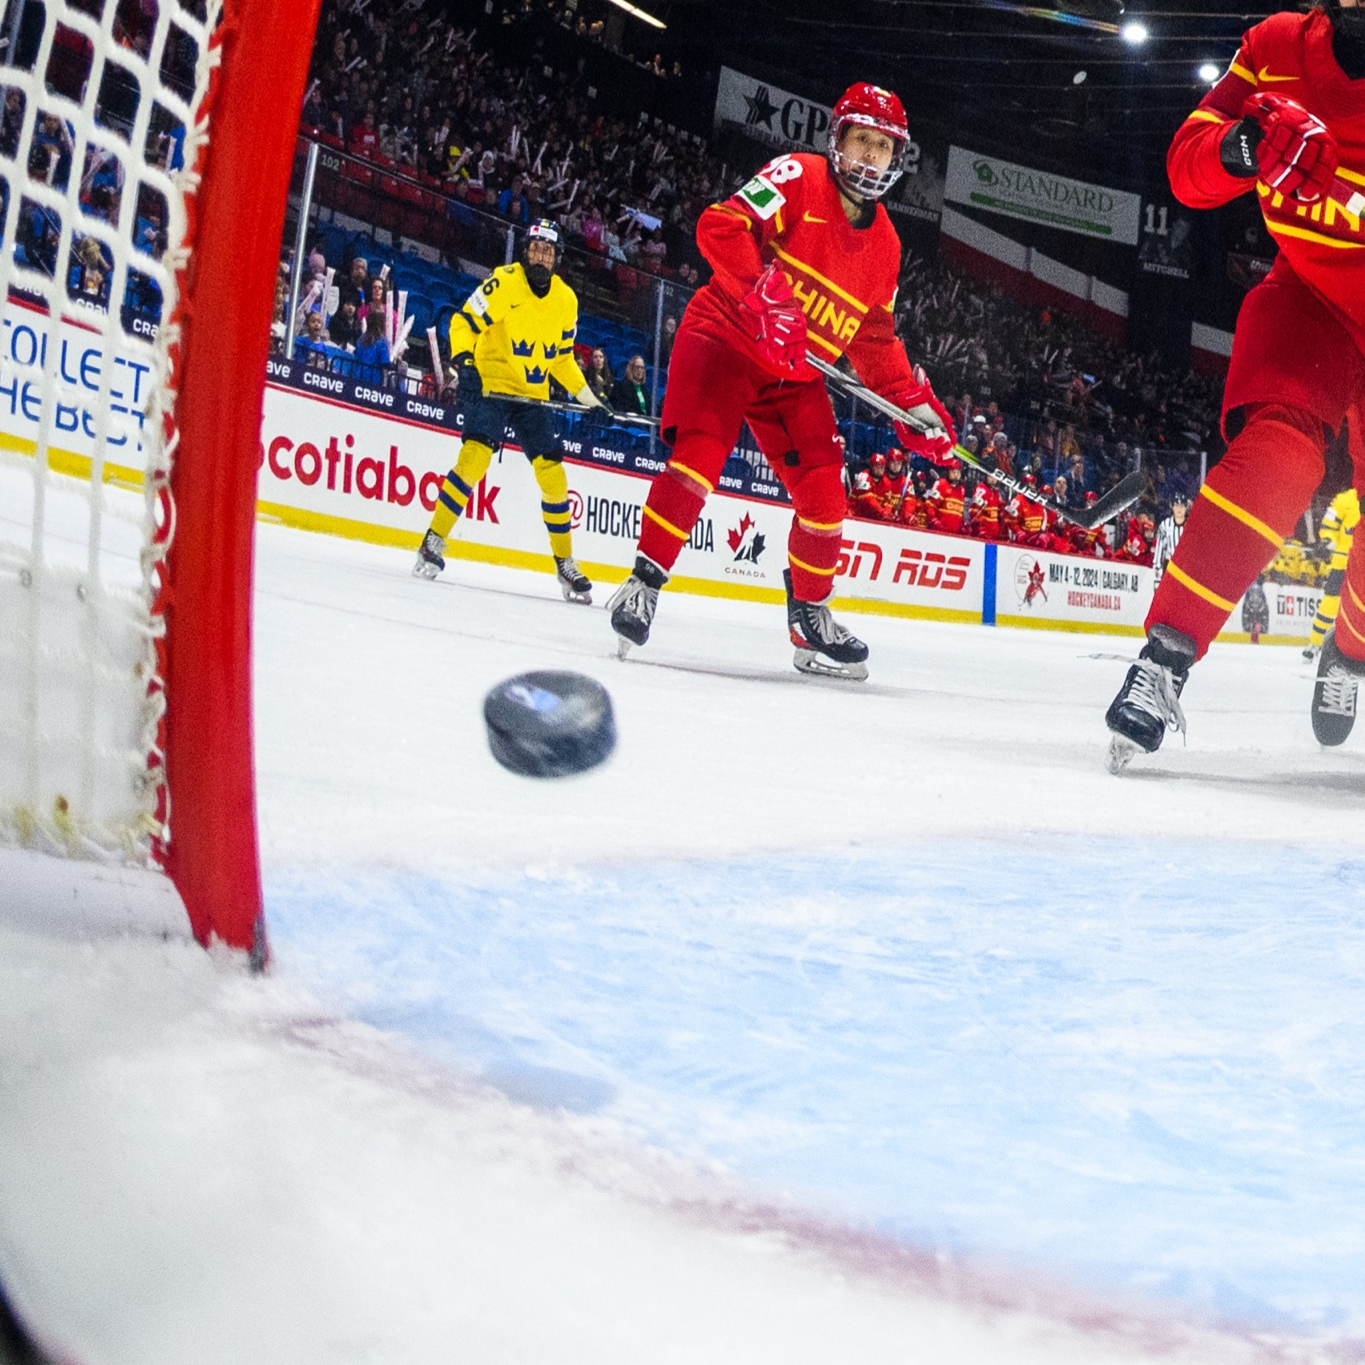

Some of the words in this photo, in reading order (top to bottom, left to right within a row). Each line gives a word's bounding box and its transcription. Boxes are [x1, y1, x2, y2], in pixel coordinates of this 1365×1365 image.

[1000, 166, 1113, 213] STANDARD
[1143, 203, 1168, 236] 11
[481, 273, 501, 297] 6
[783, 271, 862, 345] HINA
[257, 433, 501, 525] cotiabak
[724, 566, 767, 580] CANADA
[892, 547, 971, 591] RDS
[1049, 563, 1064, 583] MAY
[1082, 568, 1098, 588] 2024
